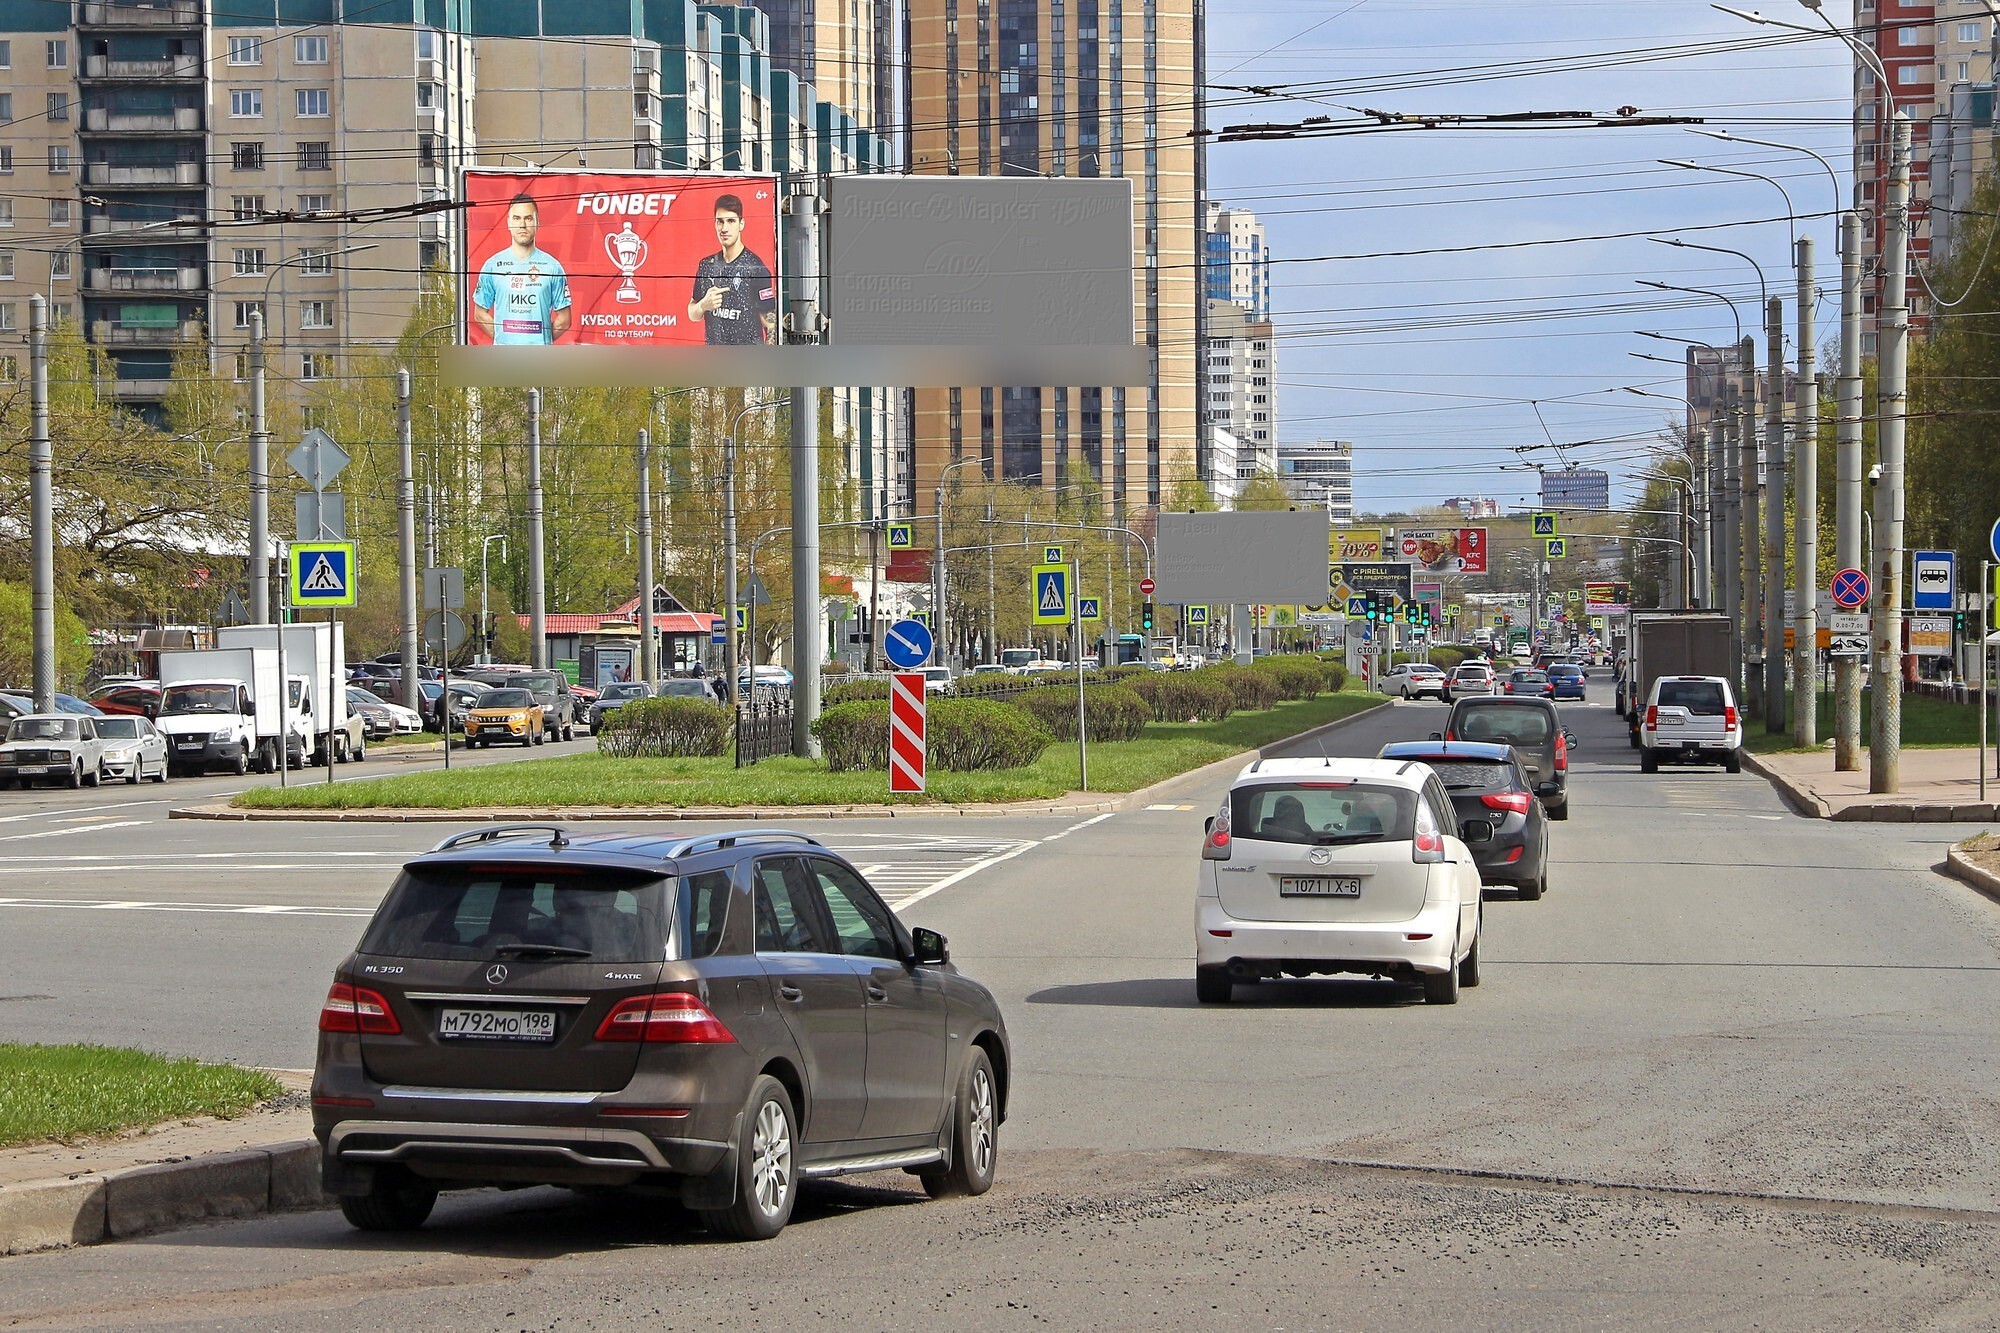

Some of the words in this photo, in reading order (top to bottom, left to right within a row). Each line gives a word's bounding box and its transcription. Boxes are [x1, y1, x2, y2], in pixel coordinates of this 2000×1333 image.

[755, 190, 768, 200] 6+
[576, 192, 677, 216] FONBET
[511, 294, 537, 305] ИКС
[581, 314, 622, 326] КУБОК
[626, 314, 677, 326] РОССИИ
[712, 307, 741, 321] ONBET
[604, 330, 616, 338] ПО
[617, 330, 654, 338] ФУТБОЛУ
[1340, 542, 1371, 558] 70%
[1294, 880, 1321, 893] 1071
[364, 965, 379, 973] ML
[380, 966, 404, 974] 350
[604, 972, 642, 980] 4MATIC
[445, 1012, 519, 1033] М792МО
[523, 1014, 551, 1028] 198
